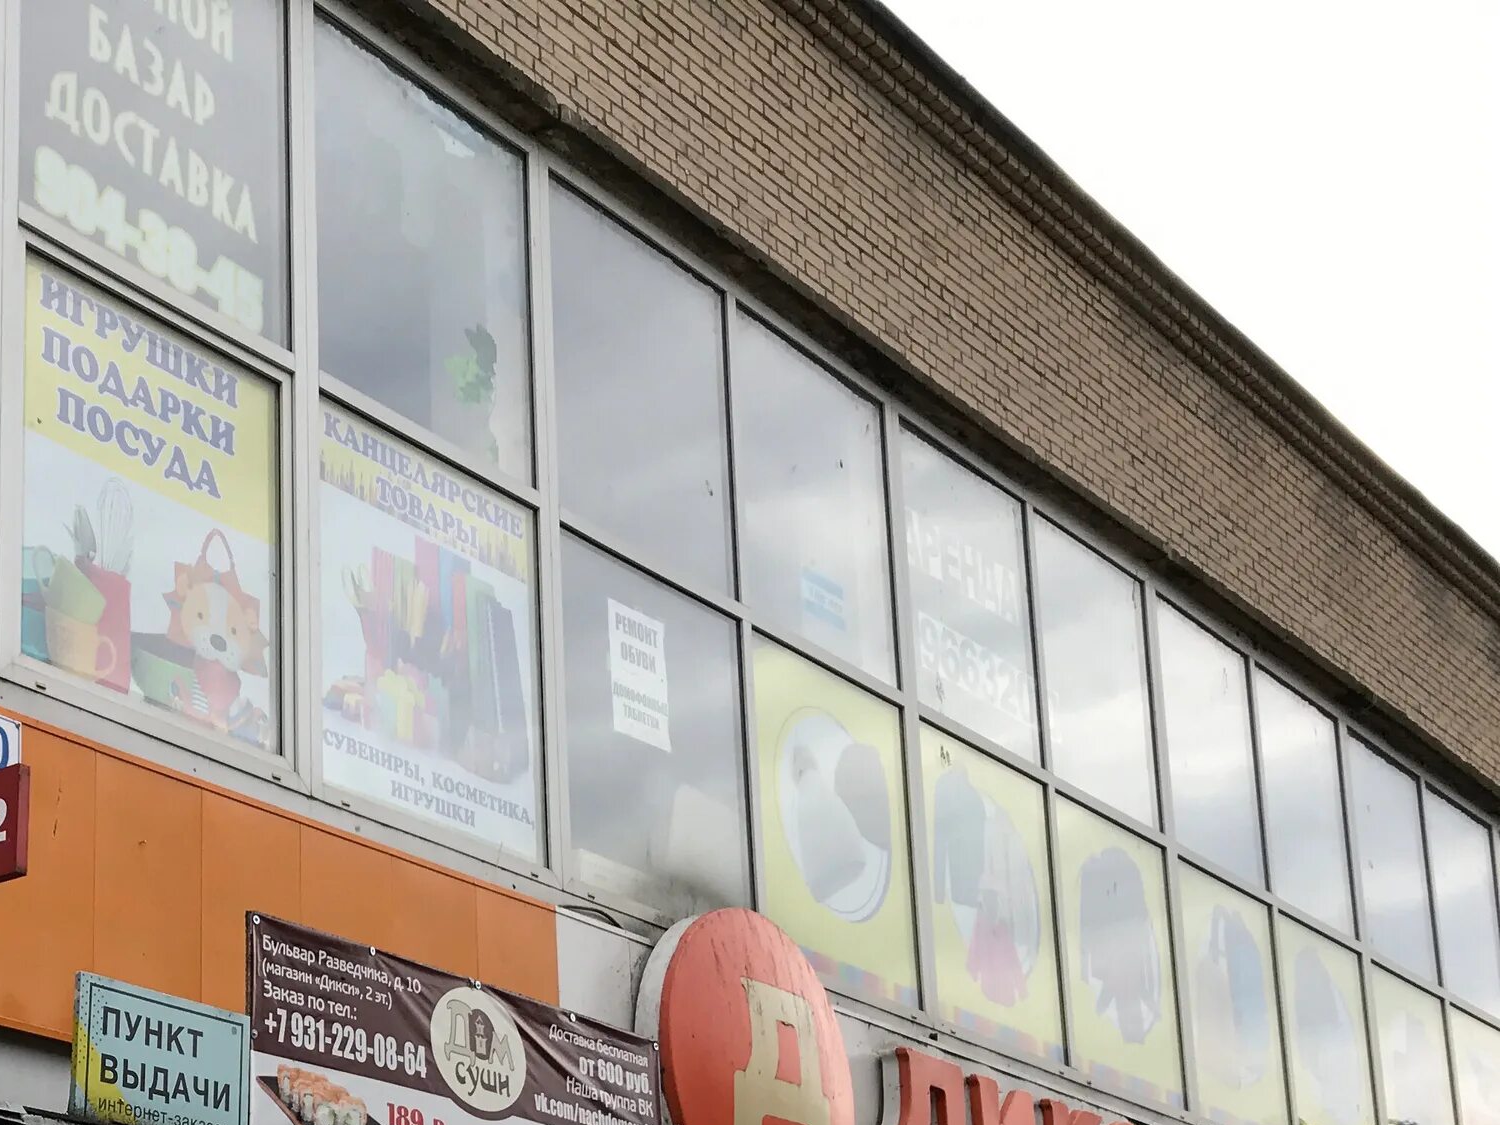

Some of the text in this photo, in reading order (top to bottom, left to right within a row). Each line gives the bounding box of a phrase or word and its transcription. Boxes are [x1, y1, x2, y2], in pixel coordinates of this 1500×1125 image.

[88, 3, 215, 126] БАЗАР
[45, 71, 258, 244] ДОСТАВКА
[39, 273, 238, 409] ИГРУШКИ
[41, 326, 235, 456] ПОДАРКИ
[57, 387, 222, 499] ПОСУДА
[323, 411, 524, 540] КАНЦЕЛЯРСКИЕ
[375, 475, 478, 547] ТОВАРЫ
[615, 612, 659, 649] РЕМОНТ
[621, 641, 657, 674] ОБУВИ
[323, 727, 535, 830] СУВЕНИРЫ, КОСМЕТИКА,
[390, 779, 476, 828] ИГРУШКИ
[262, 957, 393, 1011] (магазин «Дикси», 2 эт.)
[263, 934, 316, 967] Бульвар
[318, 950, 393, 988] Разведчика,
[406, 976, 422, 995] 10
[263, 980, 358, 1021] Заказ по тел.:
[102, 1005, 204, 1058] ПУНКТ
[291, 1011, 427, 1079] 931-229-08-64
[549, 1023, 649, 1068] Доставка бесплатная
[100, 1053, 232, 1112] ВЫДАЧИ
[566, 1076, 654, 1118] Наша группа ВК
[597, 1058, 623, 1087] 600
[626, 1071, 653, 1095] руб.
